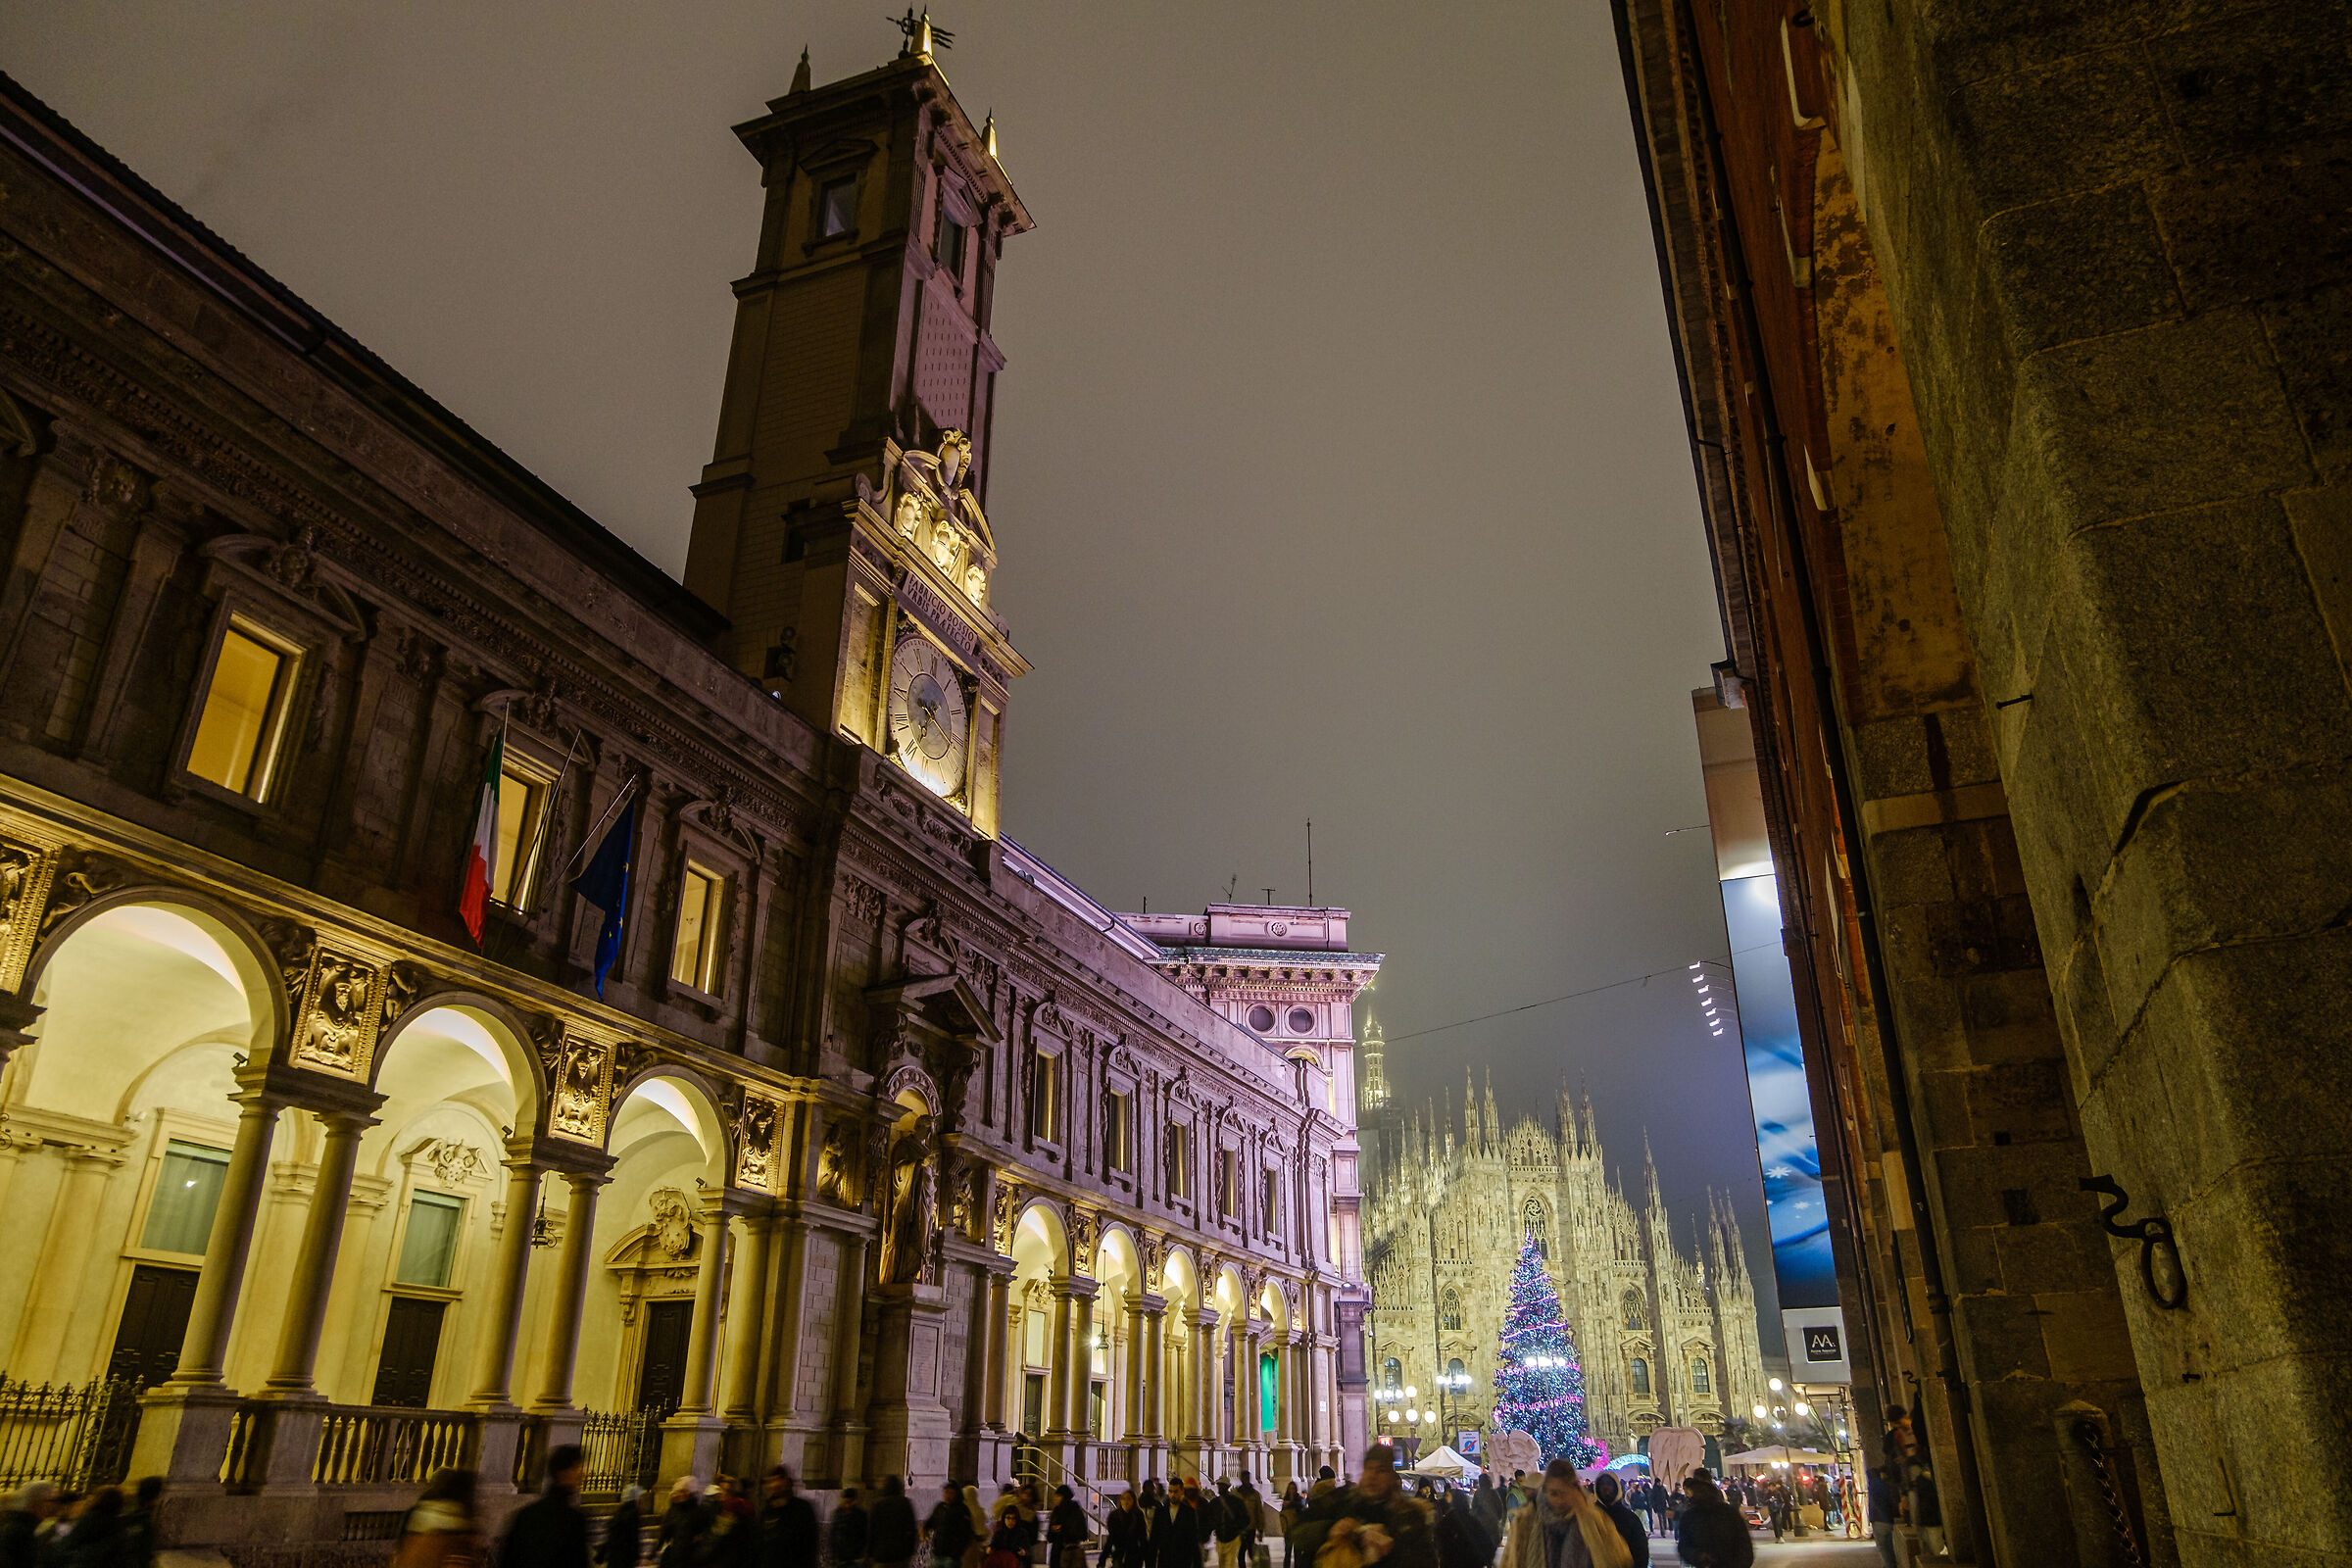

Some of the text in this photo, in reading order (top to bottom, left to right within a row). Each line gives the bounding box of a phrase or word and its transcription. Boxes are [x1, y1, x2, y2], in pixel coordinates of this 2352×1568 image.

[906, 585, 930, 612] VRBIS
[908, 573, 975, 642] FABRICIO BOSSIO
